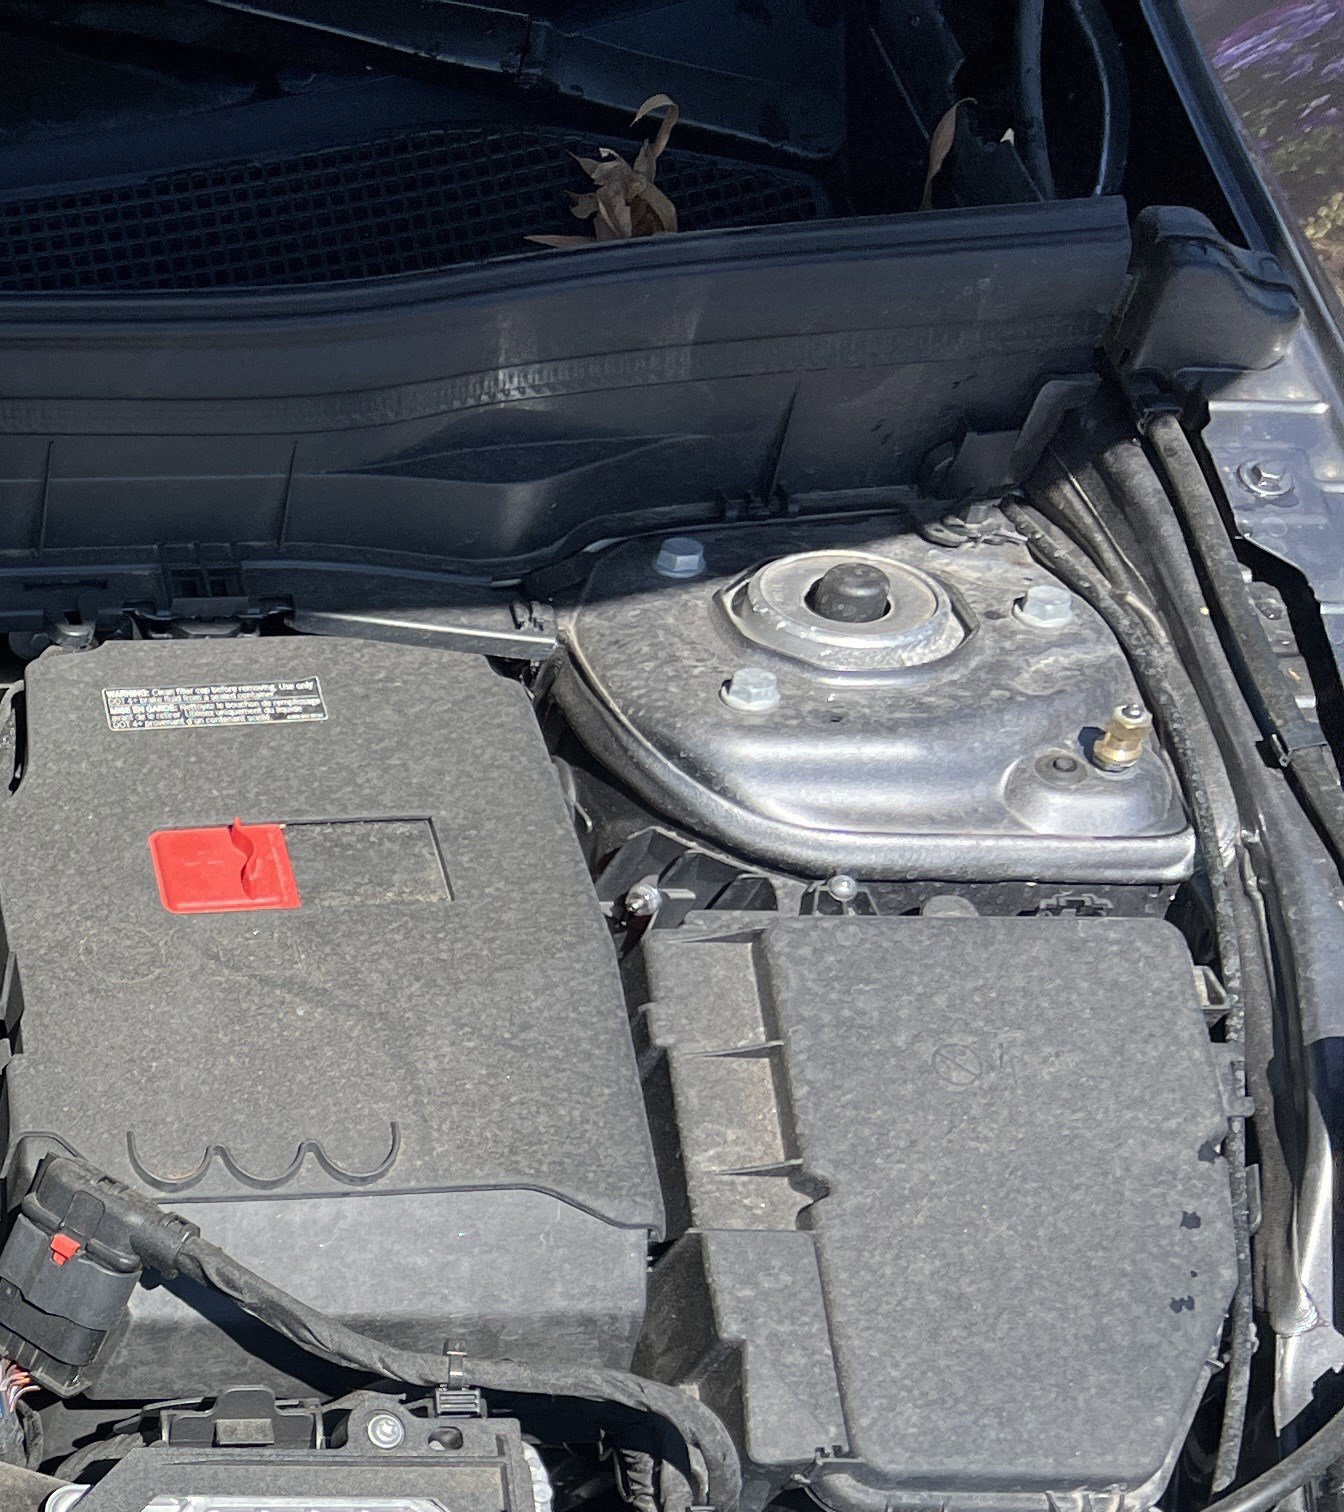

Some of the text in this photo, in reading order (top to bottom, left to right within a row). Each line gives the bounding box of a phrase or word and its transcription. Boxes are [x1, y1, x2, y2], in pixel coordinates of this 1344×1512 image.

[106, 689, 150, 698] WARNING:
[152, 688, 175, 697] Clean
[175, 687, 193, 696] filler
[194, 687, 210, 696] cap
[211, 686, 237, 694] before
[278, 683, 294, 691] Use
[296, 681, 313, 691] only
